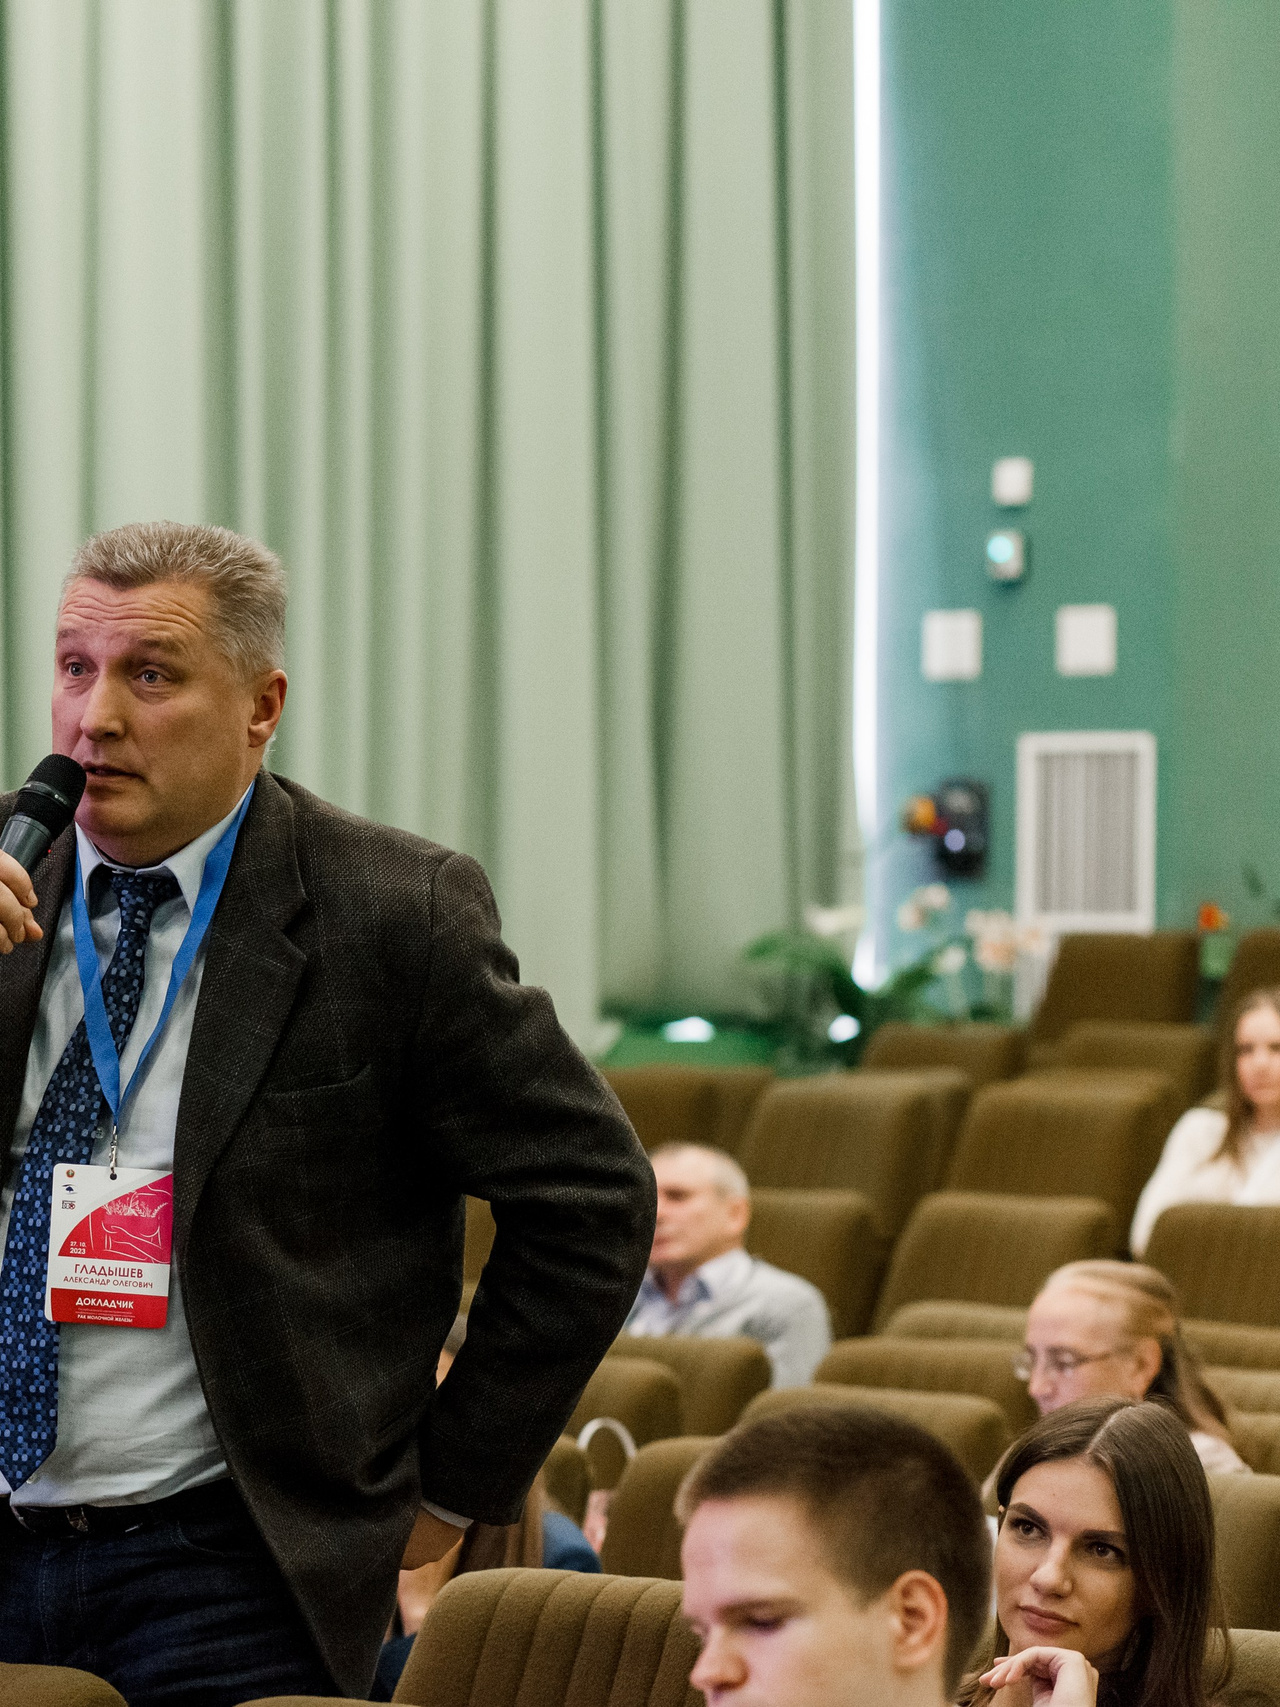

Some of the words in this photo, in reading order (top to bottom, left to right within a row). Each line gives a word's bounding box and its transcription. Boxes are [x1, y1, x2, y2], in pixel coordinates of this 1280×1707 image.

[70, 1247, 86, 1255] 2023
[74, 1264, 143, 1278] ГЛАДЫШЕВ
[63, 1276, 110, 1286] АЛЕКСАНДР
[112, 1279, 153, 1289] ОЛЕГОВИЧ
[75, 1297, 134, 1309] ДОКЛАДЧИК
